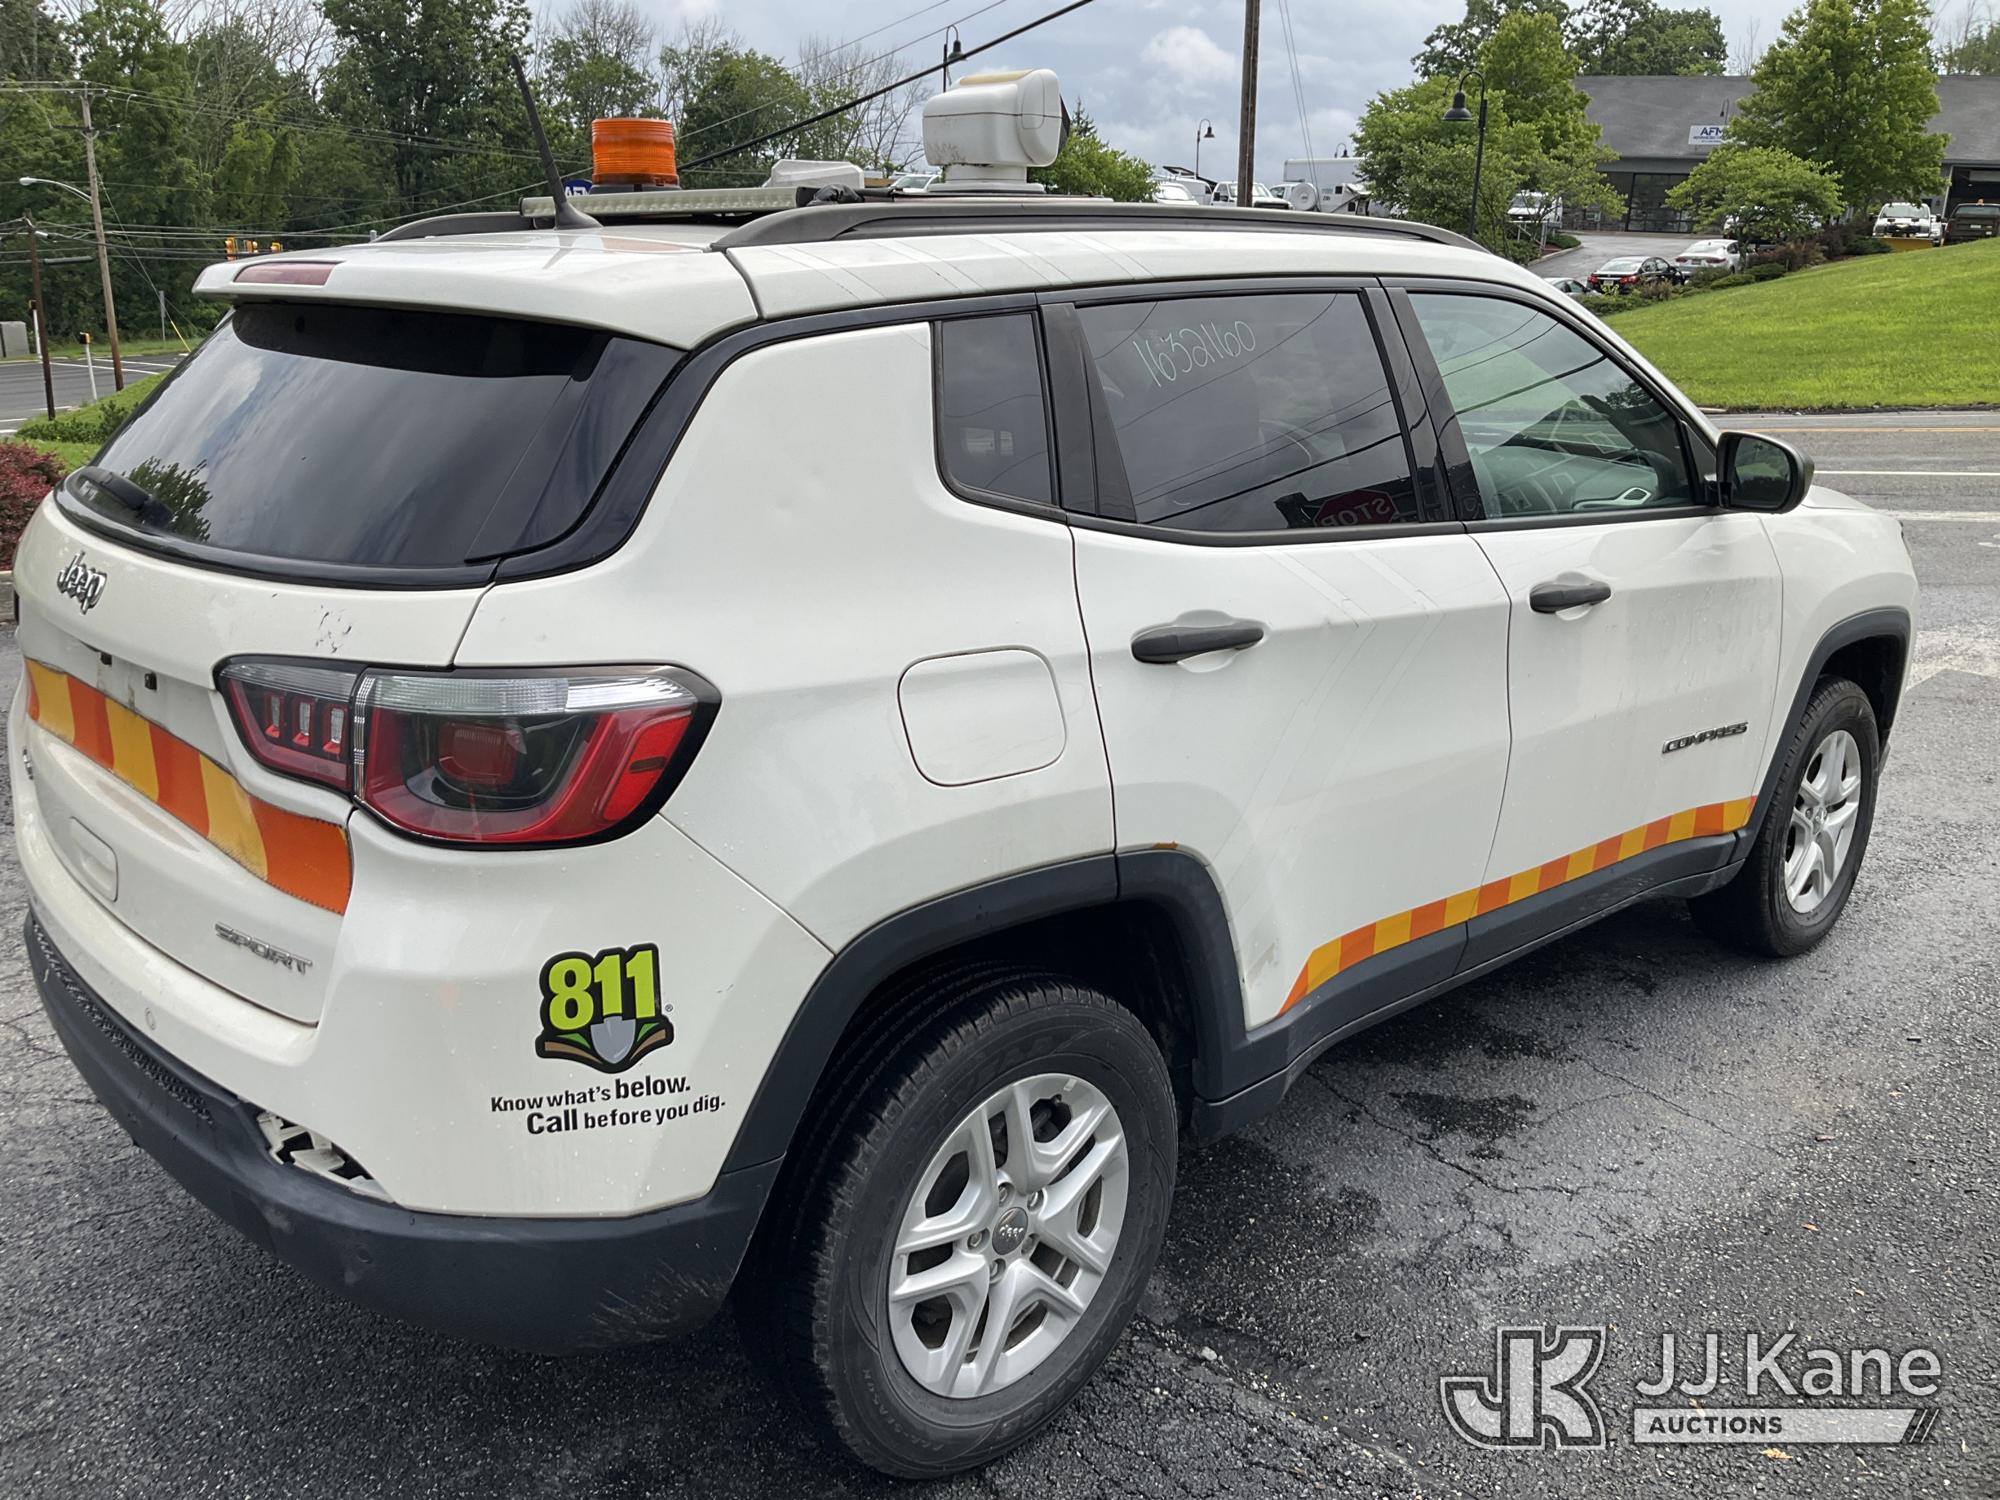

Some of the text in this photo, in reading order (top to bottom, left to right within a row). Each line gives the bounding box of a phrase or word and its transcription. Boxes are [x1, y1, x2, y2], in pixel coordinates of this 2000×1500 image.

[1132, 320, 1256, 387] 1632160
[57, 551, 107, 615] Jeep
[1662, 721, 1748, 754] COMPASS
[214, 921, 313, 975] SPORT
[491, 1096, 548, 1112] Know
[615, 1075, 691, 1099] below.
[527, 1094, 726, 1135] Call before you dig.
